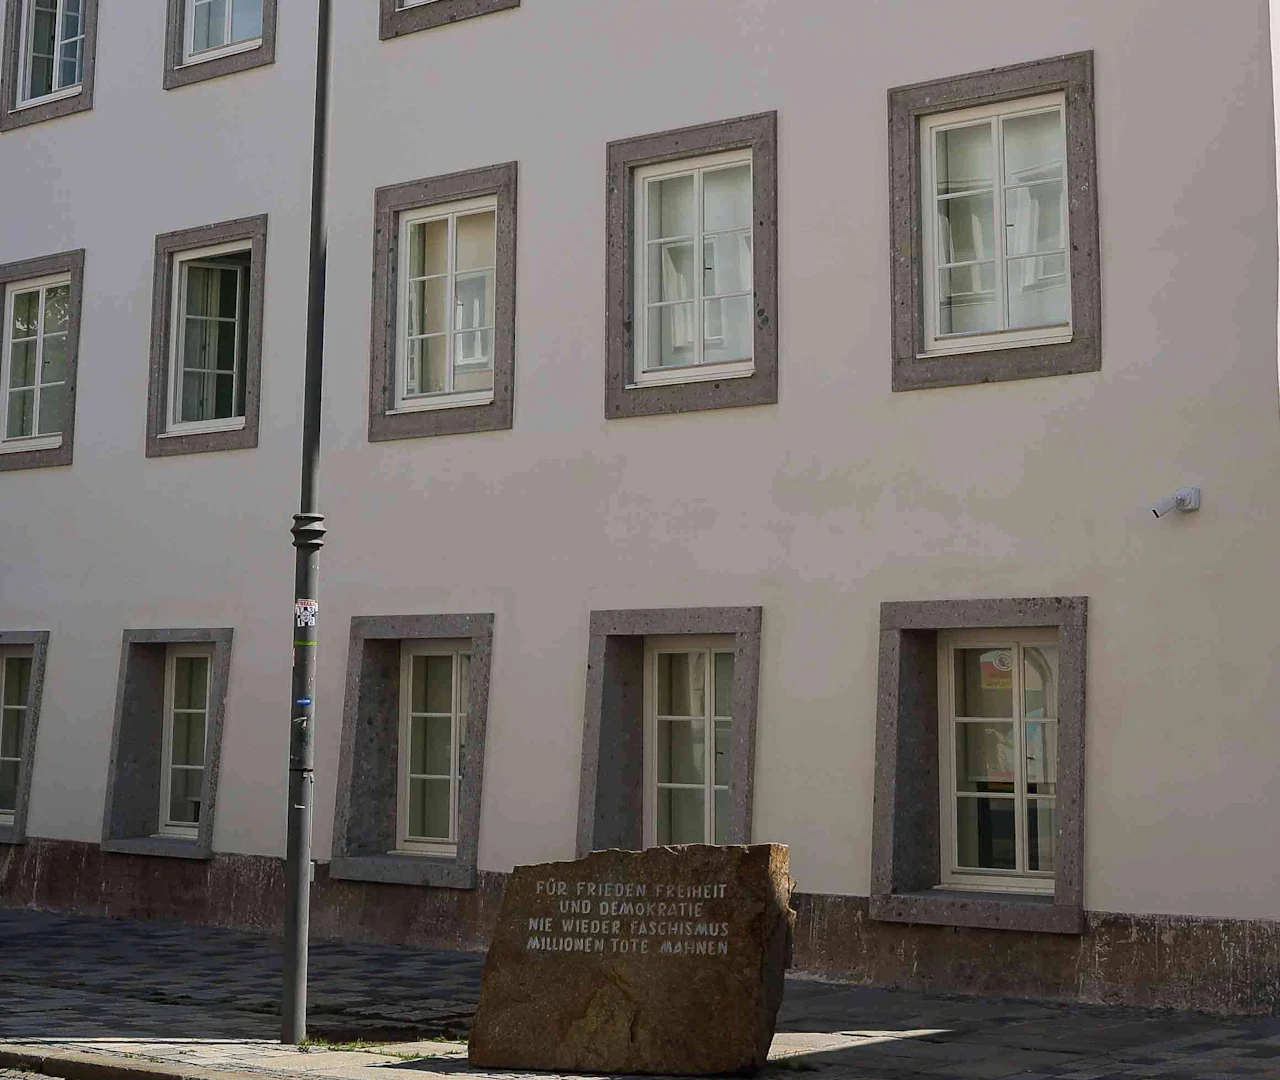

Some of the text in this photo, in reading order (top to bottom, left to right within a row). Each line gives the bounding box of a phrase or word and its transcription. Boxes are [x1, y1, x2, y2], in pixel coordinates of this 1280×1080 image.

[536, 877, 727, 899] FÜR FRIEDEN FREIHEIT
[560, 899, 704, 918] UND DEMOKRATIE
[528, 917, 729, 937] NIE WIEDER FASCHISMUS
[526, 936, 729, 956] MILLIONEN TOTE MAHNEN
